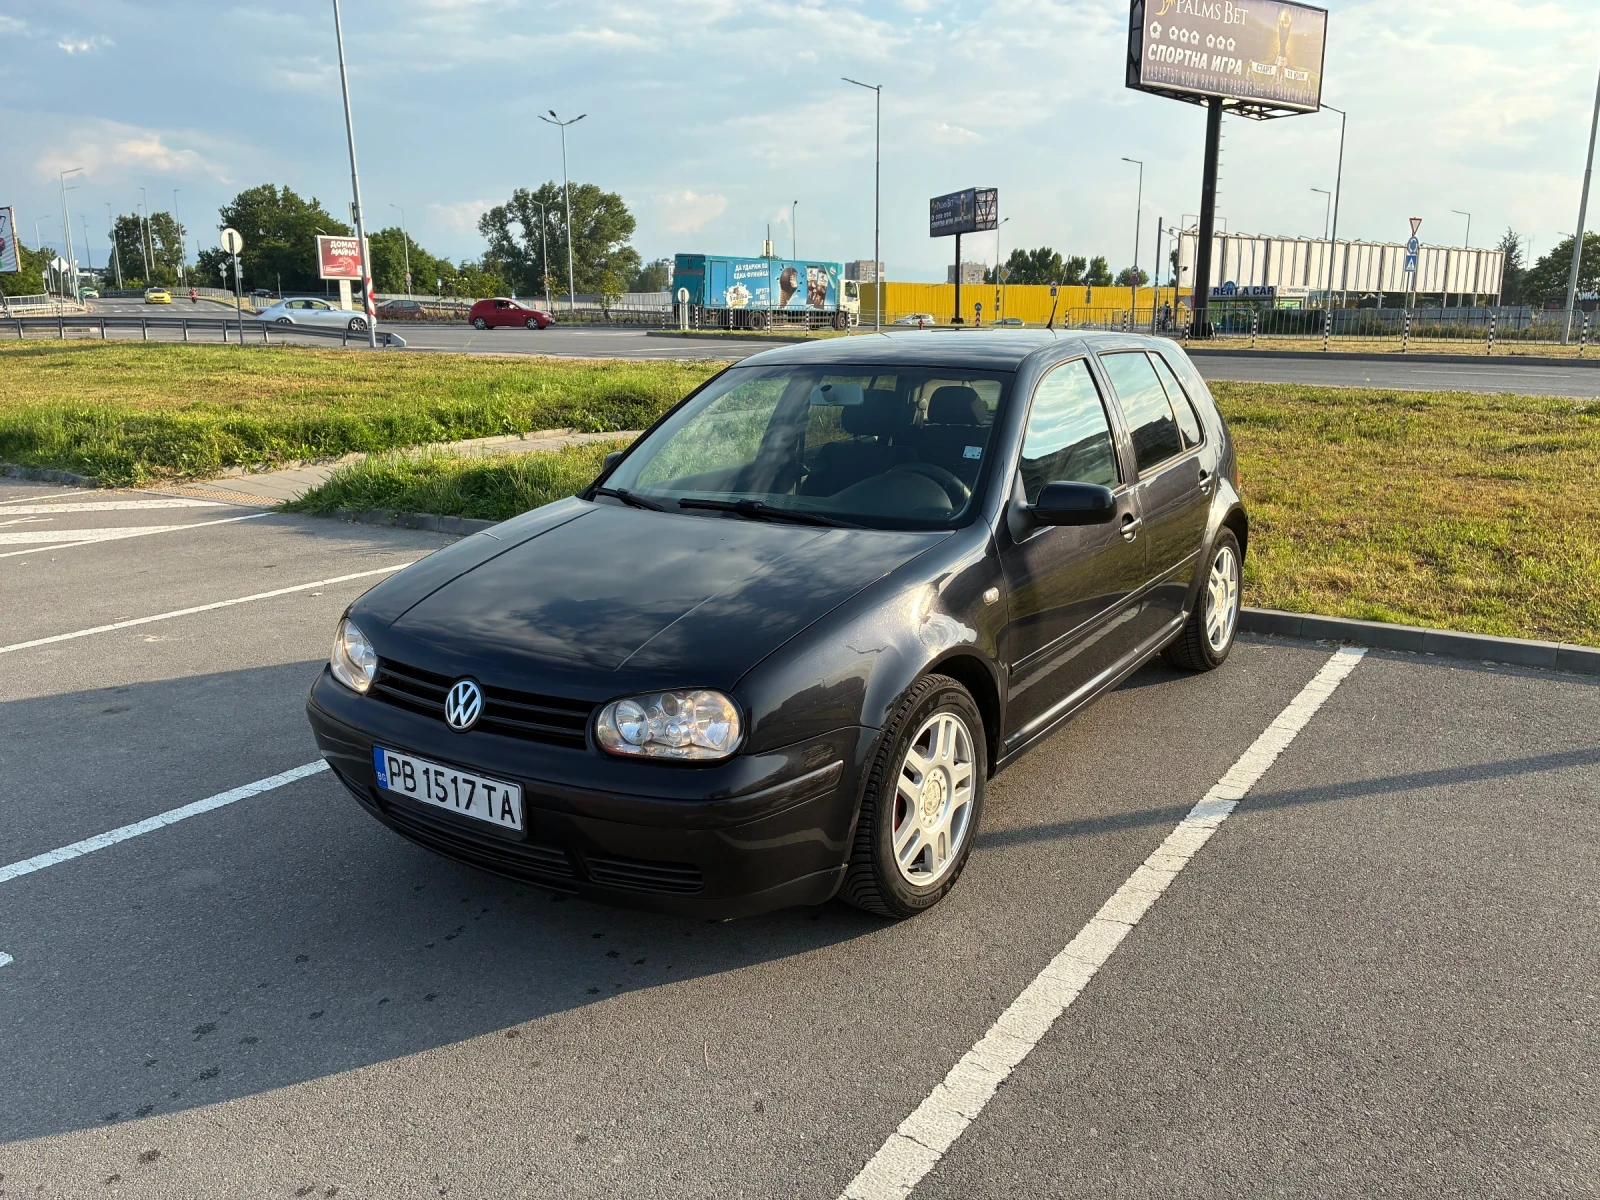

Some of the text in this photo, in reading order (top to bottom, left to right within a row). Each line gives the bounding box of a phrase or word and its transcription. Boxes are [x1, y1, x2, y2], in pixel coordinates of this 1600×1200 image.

[1176, 0, 1249, 25] PALMS BET
[1147, 43, 1243, 76] СПОРТНА ИГРА
[1256, 64, 1273, 74] СТАРТ
[1242, 287, 1249, 295] A
[1252, 286, 1274, 295] CAR
[387, 755, 516, 824] PB 1517 TA
